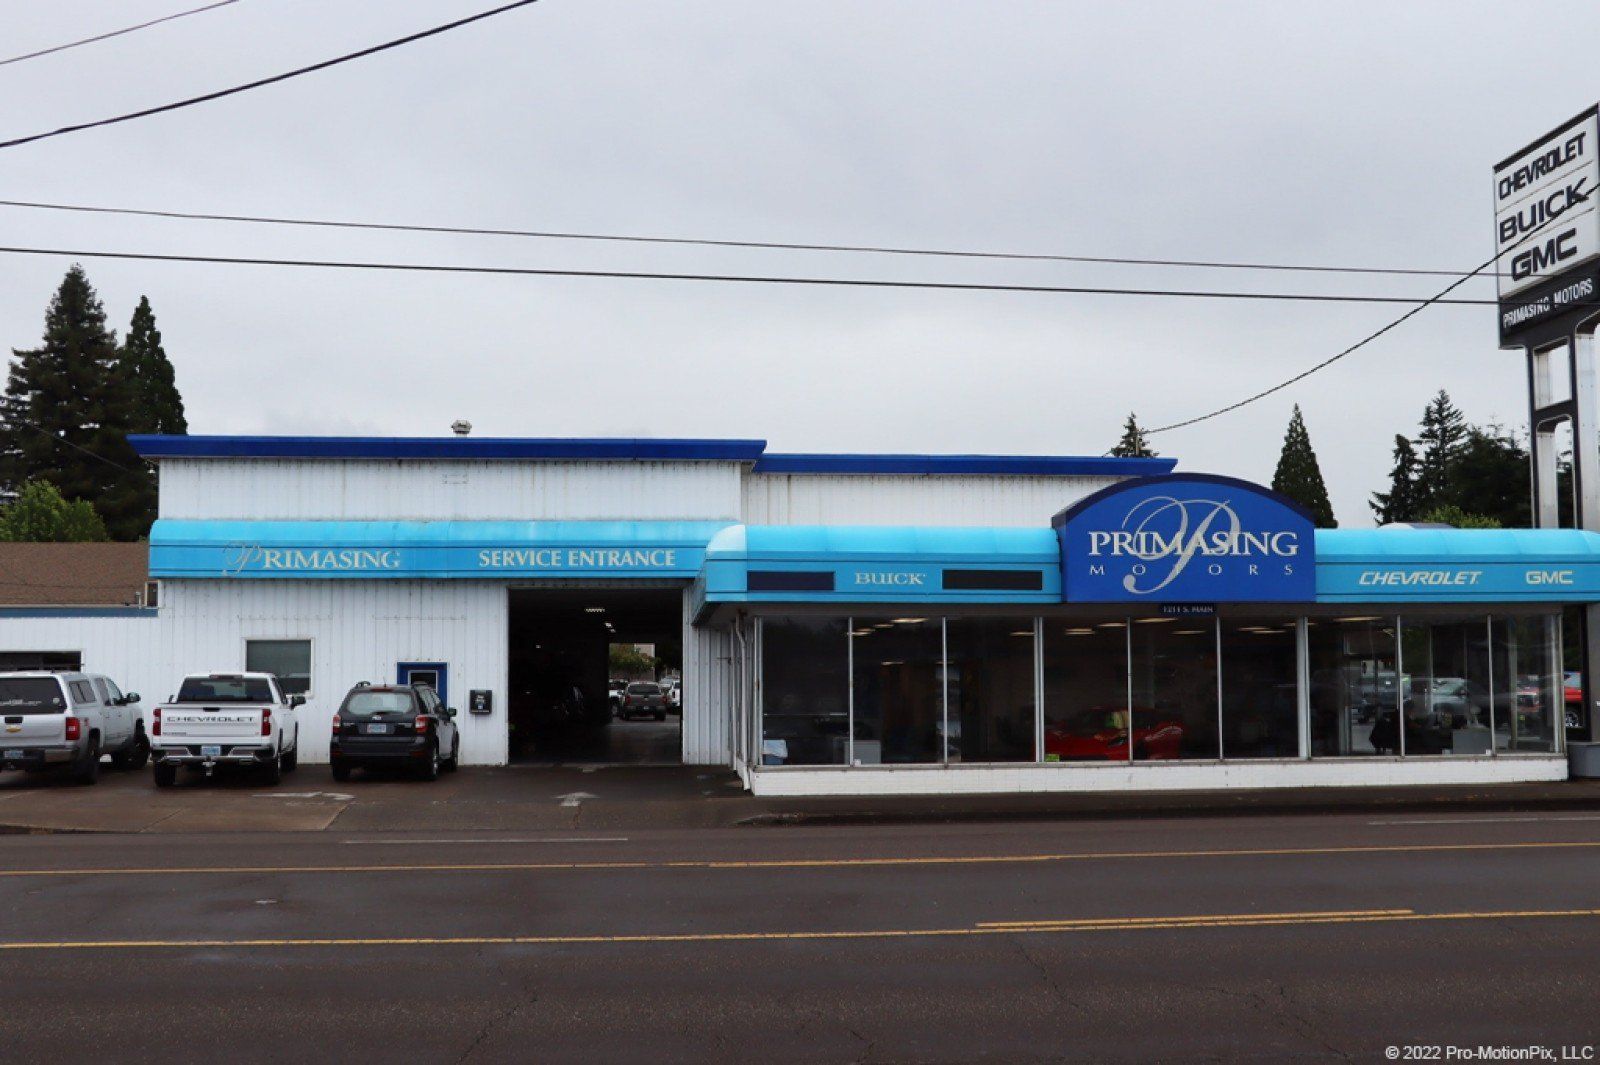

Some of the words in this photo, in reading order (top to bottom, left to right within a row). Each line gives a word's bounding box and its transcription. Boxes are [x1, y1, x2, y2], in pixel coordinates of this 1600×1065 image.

[1499, 131, 1586, 200] CHEVROLET
[1499, 177, 1589, 244] BUICK
[1511, 227, 1577, 281] GMC
[1502, 297, 1550, 329] PRIMASING
[1554, 278, 1593, 307] MOTORS
[222, 541, 400, 576] PRIMASING
[479, 550, 561, 567] SERVICE
[568, 550, 675, 566] ENTRANCE
[1088, 531, 1299, 556] PRIMASING
[855, 572, 924, 585] BUICK
[1359, 571, 1482, 584] CHEVROLET
[1526, 570, 1573, 584] GMC
